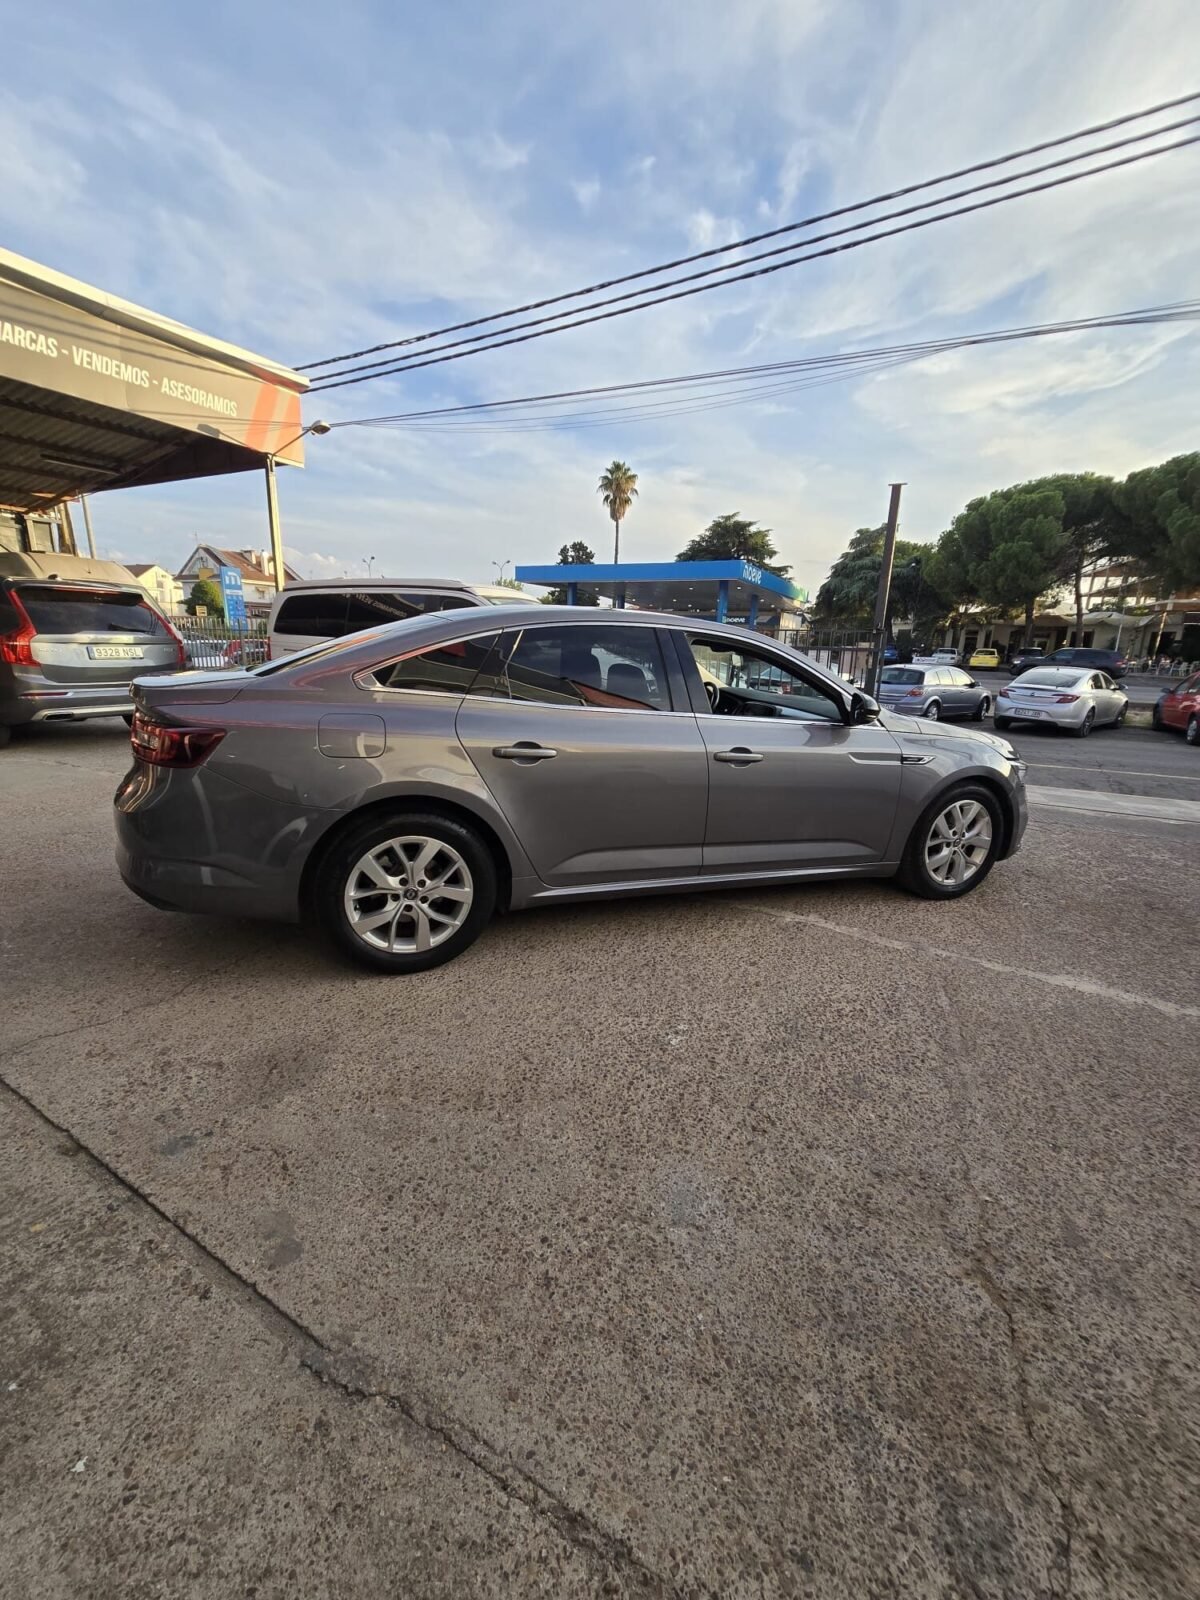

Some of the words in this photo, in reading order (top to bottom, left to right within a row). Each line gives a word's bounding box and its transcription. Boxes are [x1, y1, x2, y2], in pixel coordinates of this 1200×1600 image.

[0, 320, 58, 358] ARCAS
[72, 345, 150, 388] VENDEMOS
[161, 376, 238, 417] ASESORAMOS
[96, 647, 121, 657] 9328
[122, 647, 140, 657] NSL
